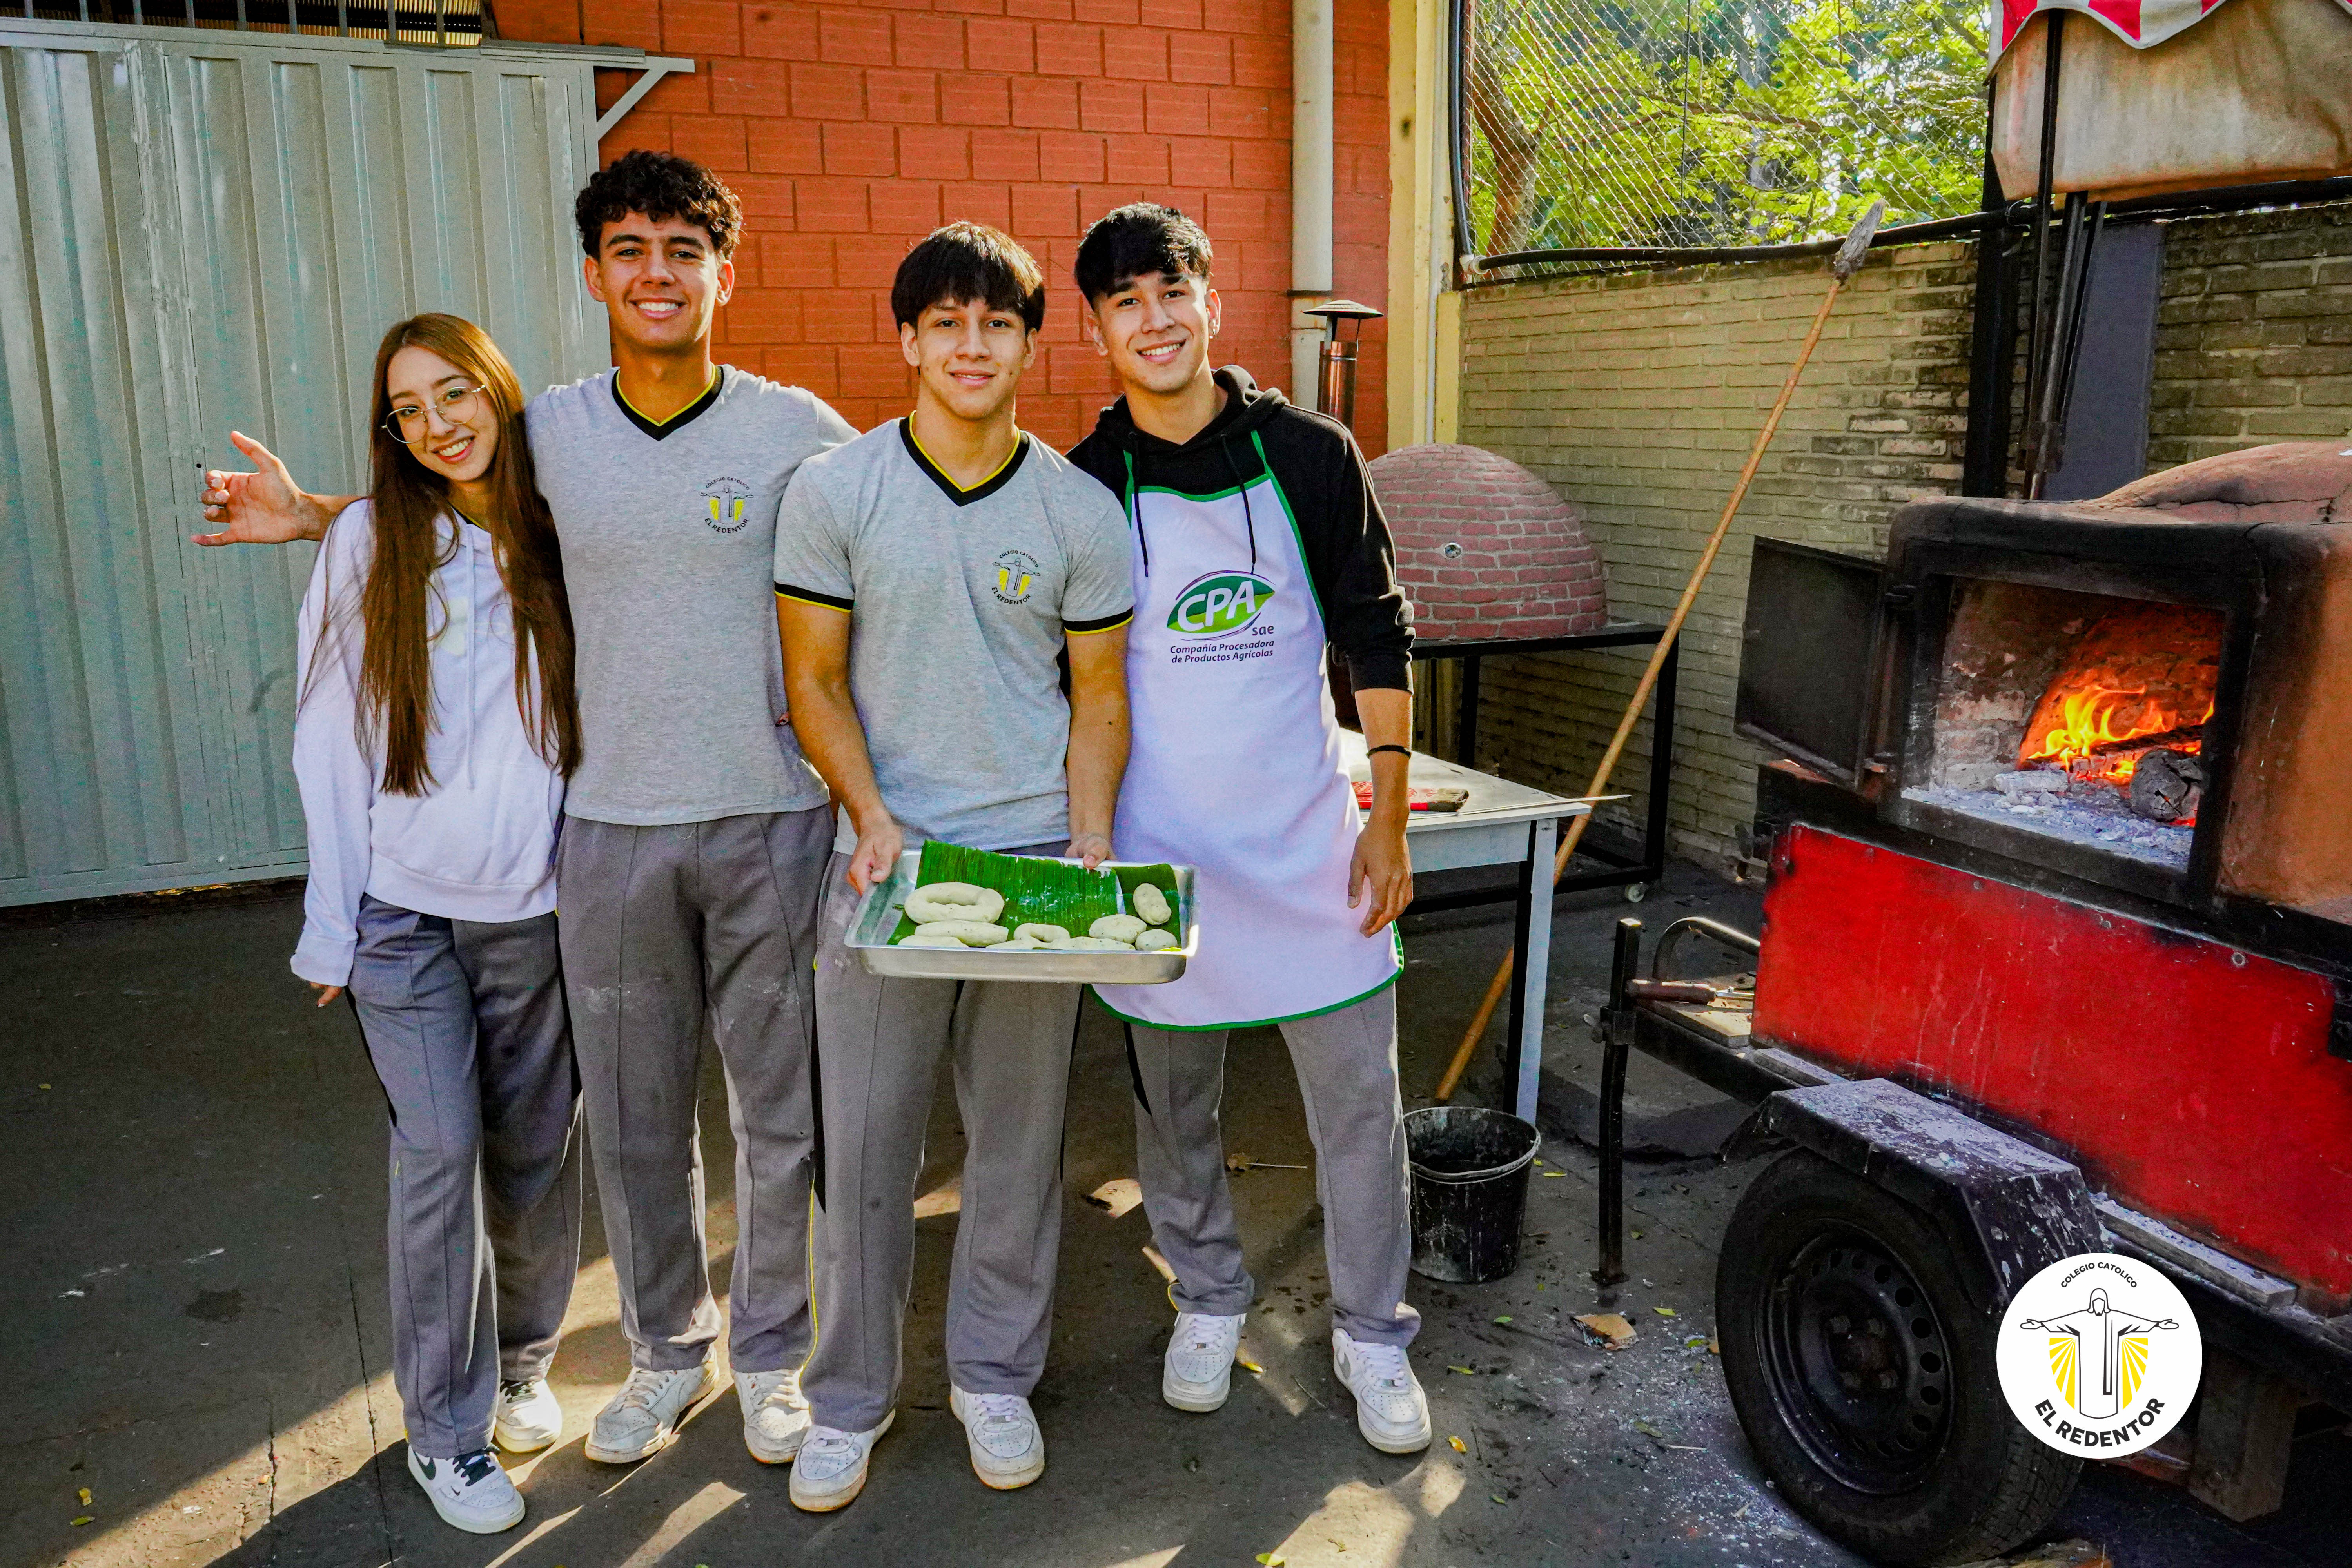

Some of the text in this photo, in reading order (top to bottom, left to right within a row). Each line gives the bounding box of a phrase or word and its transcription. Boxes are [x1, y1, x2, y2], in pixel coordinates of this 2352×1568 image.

[706, 477, 750, 490] COLEGIO CATOLICO
[705, 518, 749, 533] EL REDENTOR
[1000, 550, 1038, 568] COLEGIO CATOLICO
[996, 594, 1031, 604] REDENTOR
[1178, 580, 1256, 631] CPA
[1252, 626, 1274, 636] sae
[1171, 640, 1274, 654] Compañía Procesadora
[1184, 654, 1230, 663] Productos
[1232, 649, 1273, 661] Agrícolas
